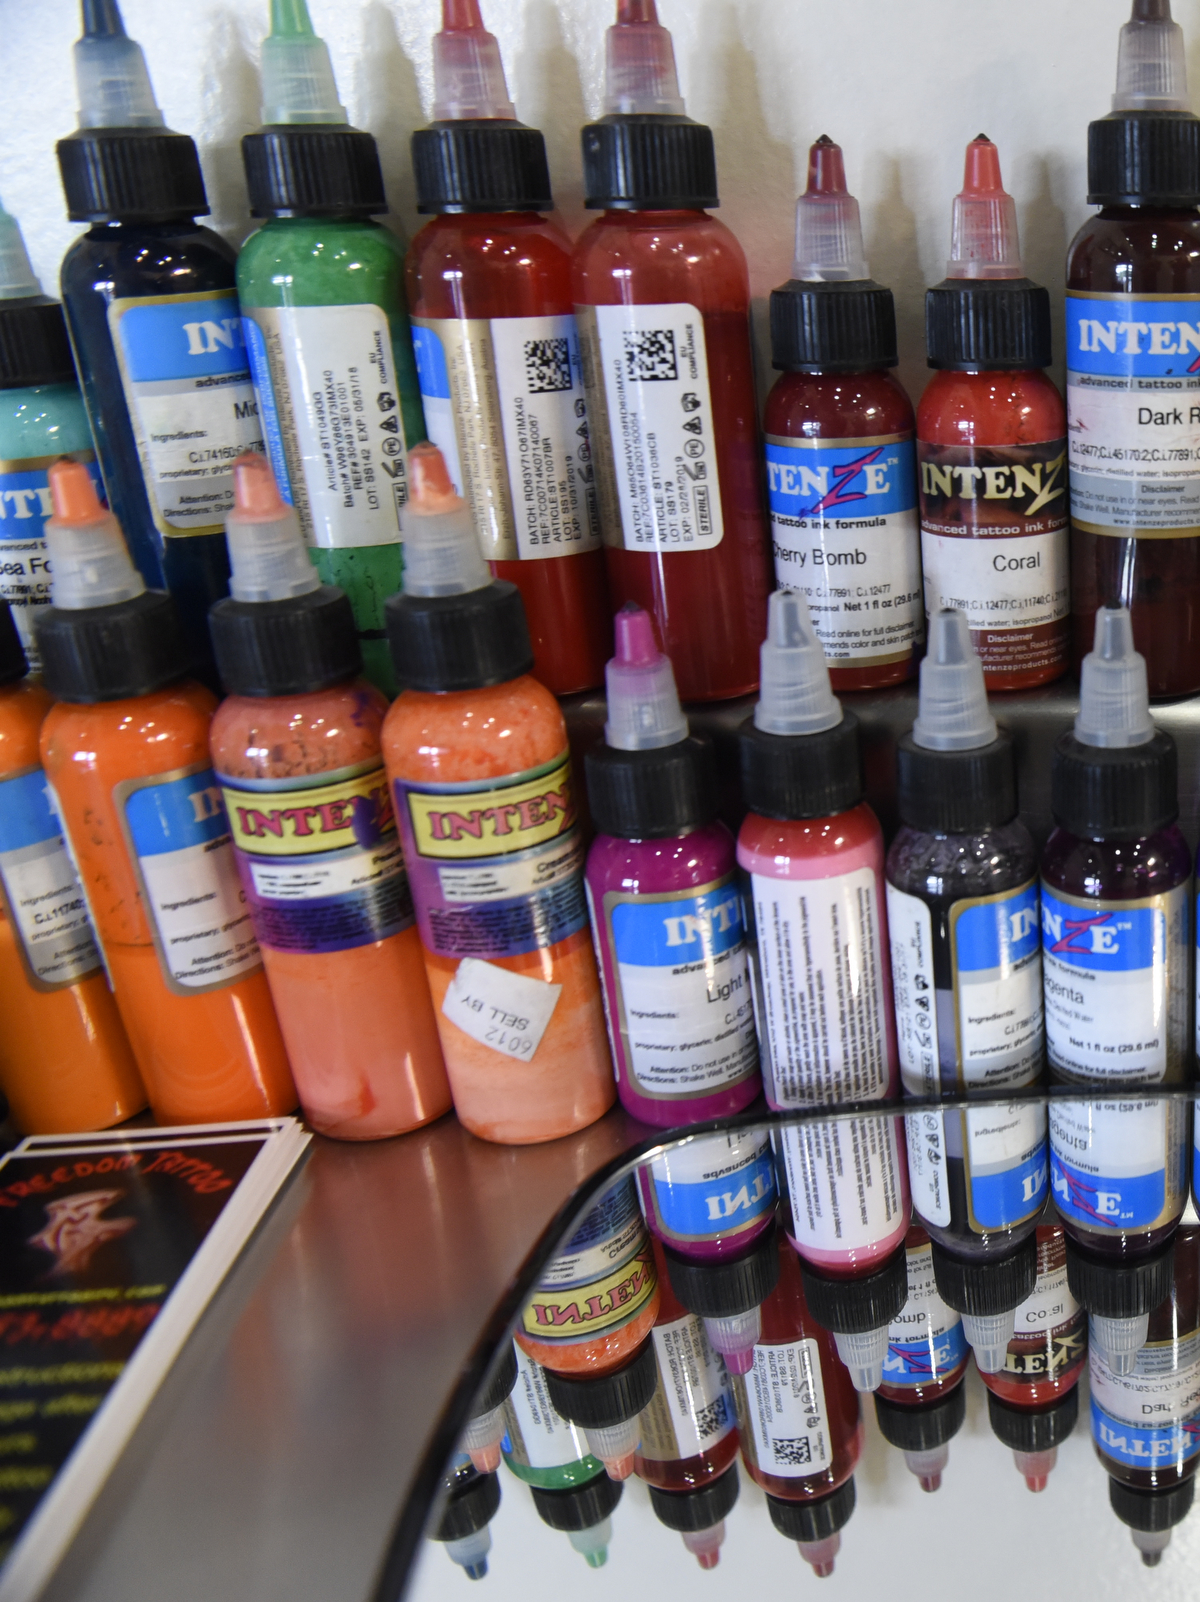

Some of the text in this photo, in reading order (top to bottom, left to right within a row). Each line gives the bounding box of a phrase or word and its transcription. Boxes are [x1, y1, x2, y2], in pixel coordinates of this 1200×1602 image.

[680, 346, 688, 358] EU
[685, 323, 698, 379] COMPLIANCE
[1138, 379, 1183, 389] tattoo
[1138, 407, 1183, 426] Dark
[349, 461, 364, 490] REF#
[767, 447, 891, 513] TENZE
[920, 448, 1067, 516] INTENZ
[696, 489, 710, 532] STERILE
[811, 517, 831, 529] ink
[835, 516, 886, 528] formula
[682, 516, 694, 542] EXP:
[971, 524, 1021, 535] tattoo
[1024, 521, 1044, 532] ink
[812, 548, 867, 566] Bomb
[993, 551, 1041, 573] Coral
[844, 603, 862, 611] Net
[428, 783, 570, 840] INTEN
[706, 976, 743, 1003] Light
[460, 994, 530, 1032] SELL BY
[484, 1025, 533, 1055] 6012
